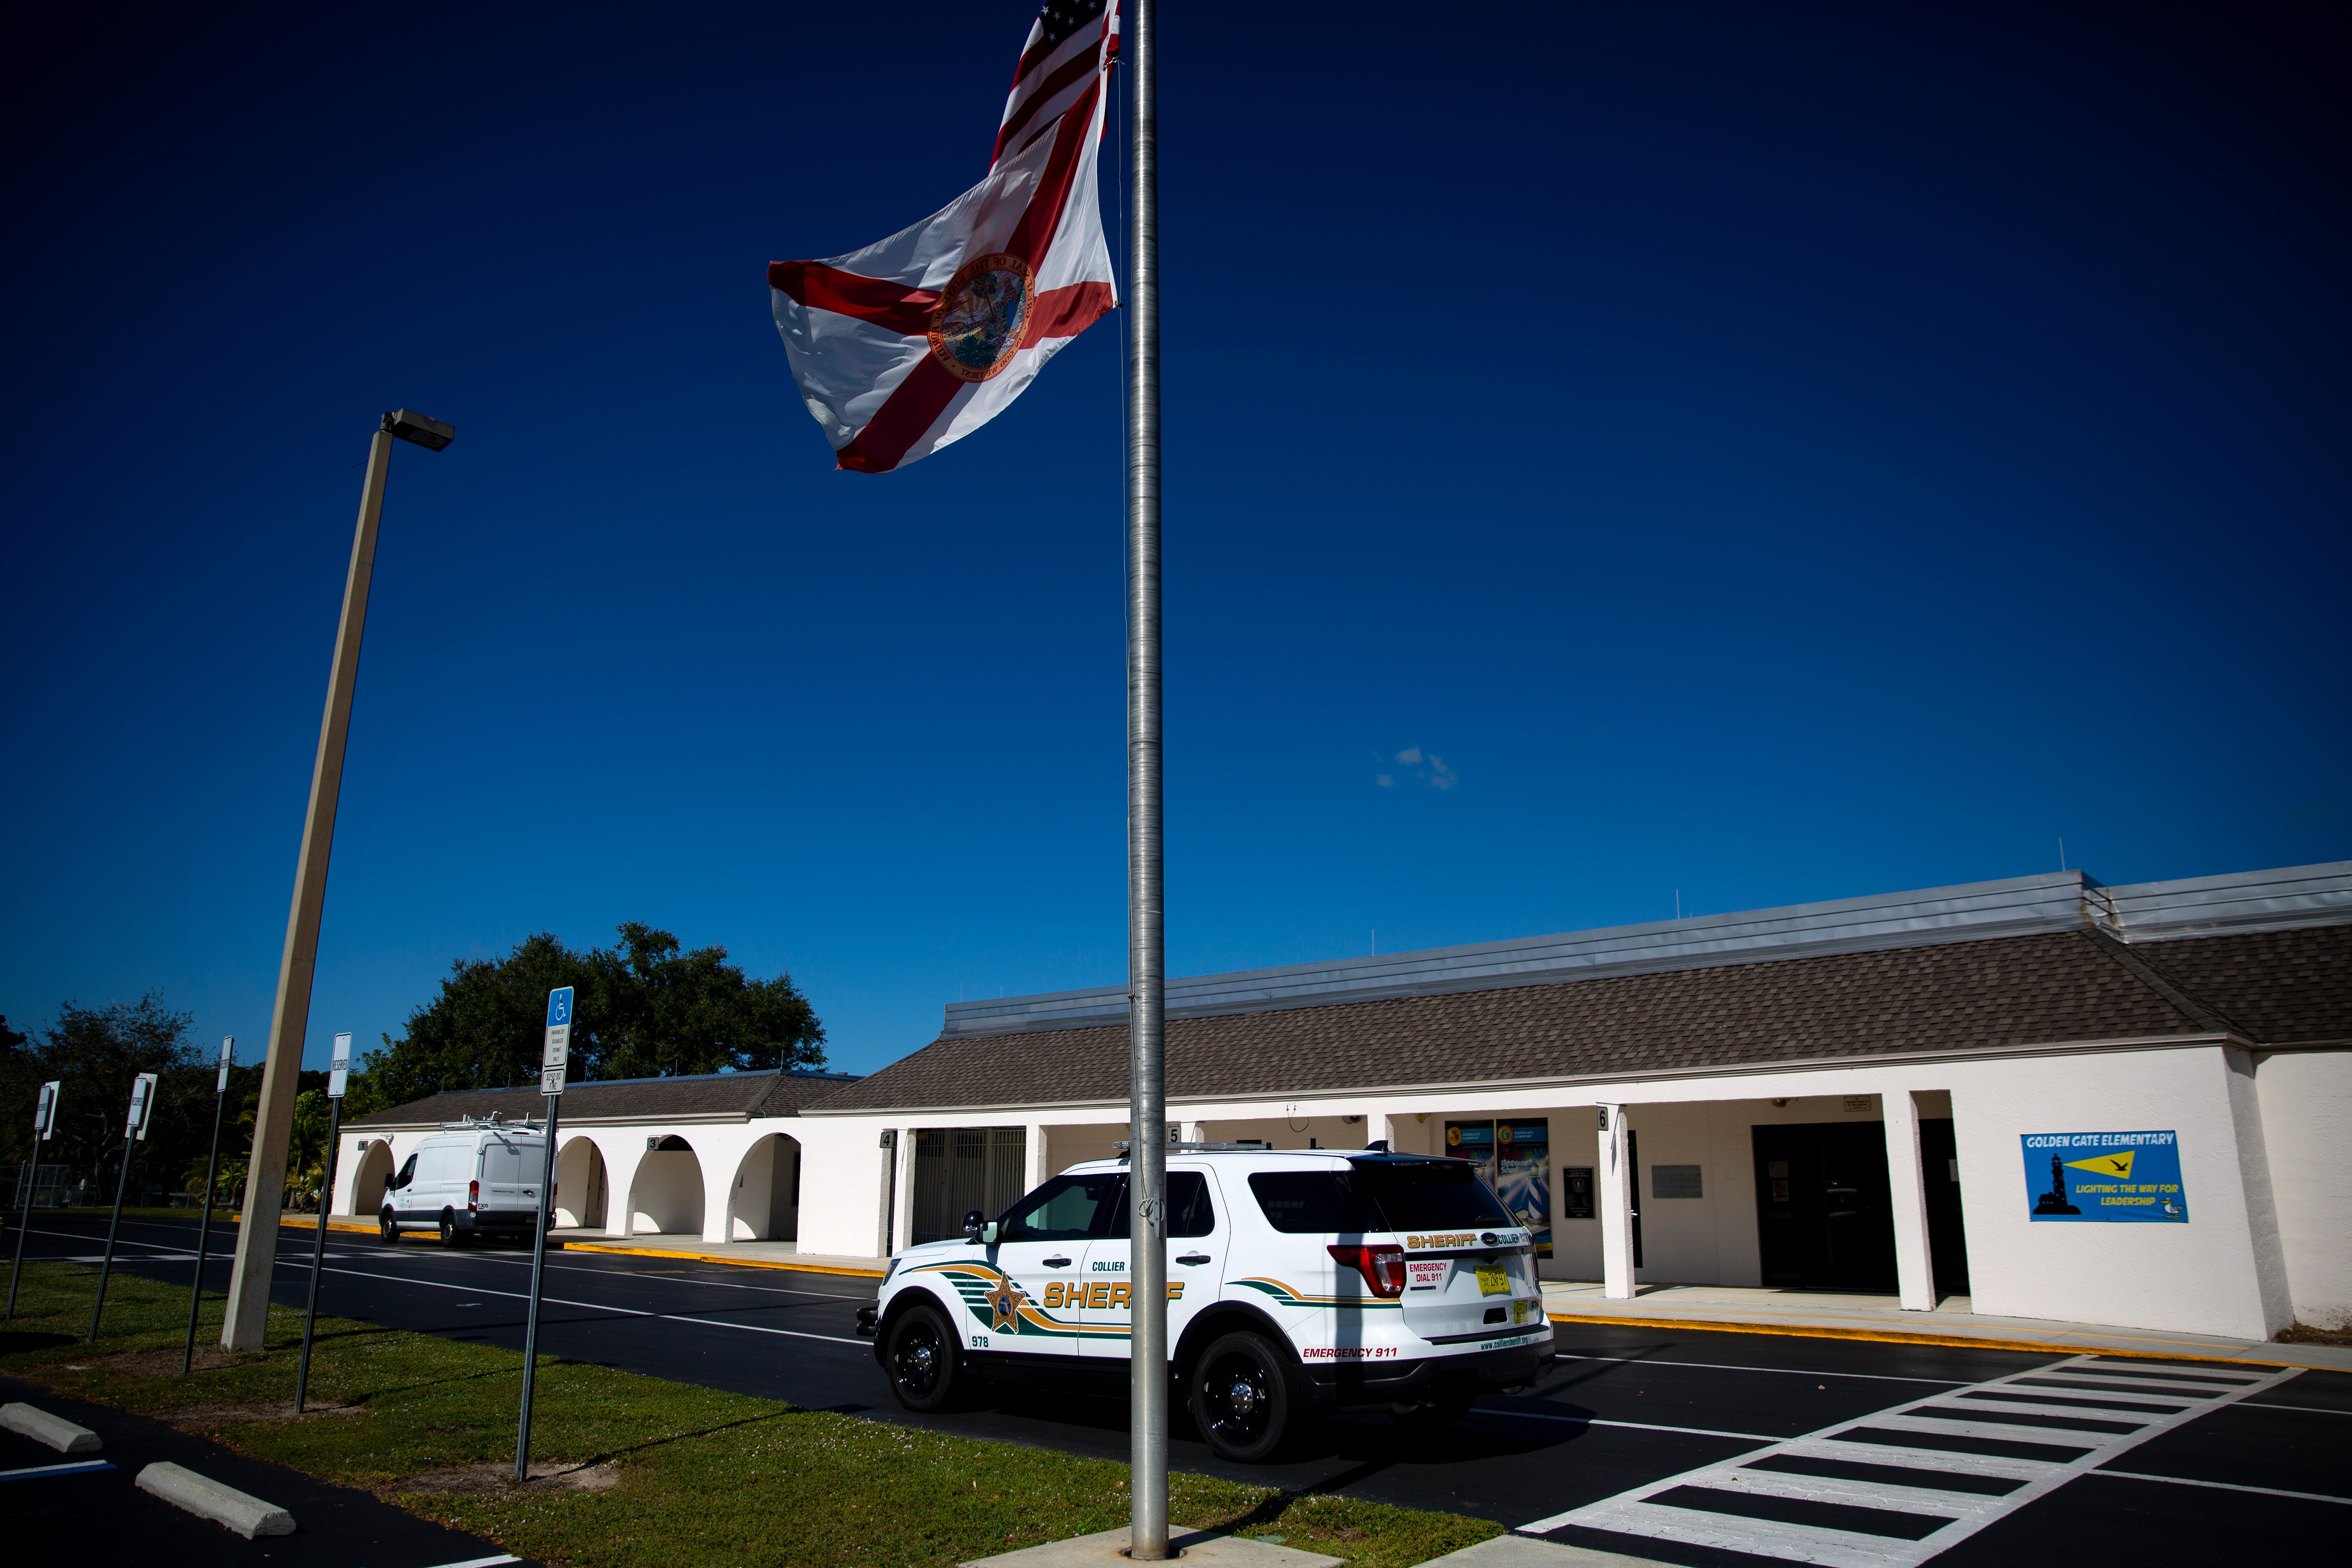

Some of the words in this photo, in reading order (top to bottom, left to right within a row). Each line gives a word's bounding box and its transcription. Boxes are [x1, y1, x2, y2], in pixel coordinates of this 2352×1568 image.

[546, 1072, 561, 1081] $250.00
[1600, 1110, 1605, 1127] 6
[883, 1135, 889, 1146] 4
[1171, 1129, 1177, 1142] 5
[2027, 1136, 2070, 1148] GOLDEN
[2072, 1135, 2099, 1147] GATE
[2102, 1133, 2174, 1146] ELEMENTARY
[650, 1139, 656, 1148] 3
[1471, 1150, 1477, 1158] in
[1478, 1149, 1491, 1158] Me
[1499, 1147, 1524, 1158] Leader
[1525, 1148, 1532, 1158] in
[1533, 1148, 1547, 1158] Me
[2076, 1185, 2118, 1193] LIGHTING
[2120, 1185, 2137, 1193] THE
[2139, 1185, 2158, 1193] WAY
[2159, 1184, 2179, 1193] FOR
[2101, 1197, 2156, 1205] LEADERSHIP
[1407, 1233, 1477, 1249] SHERIFF
[1497, 1233, 1520, 1244] COLLIER
[1092, 1262, 1125, 1272] COLLIER
[1409, 1262, 1447, 1272] EMERGENCY
[1416, 1274, 1430, 1282] DIAL
[1432, 1273, 1442, 1281] 911
[1043, 1282, 1185, 1309] SHERF
[972, 1336, 988, 1348] 978
[1481, 1336, 1528, 1350] www.colliersheriff.org
[1303, 1348, 1373, 1358] EMERGENCY
[1375, 1348, 1397, 1357] 911
